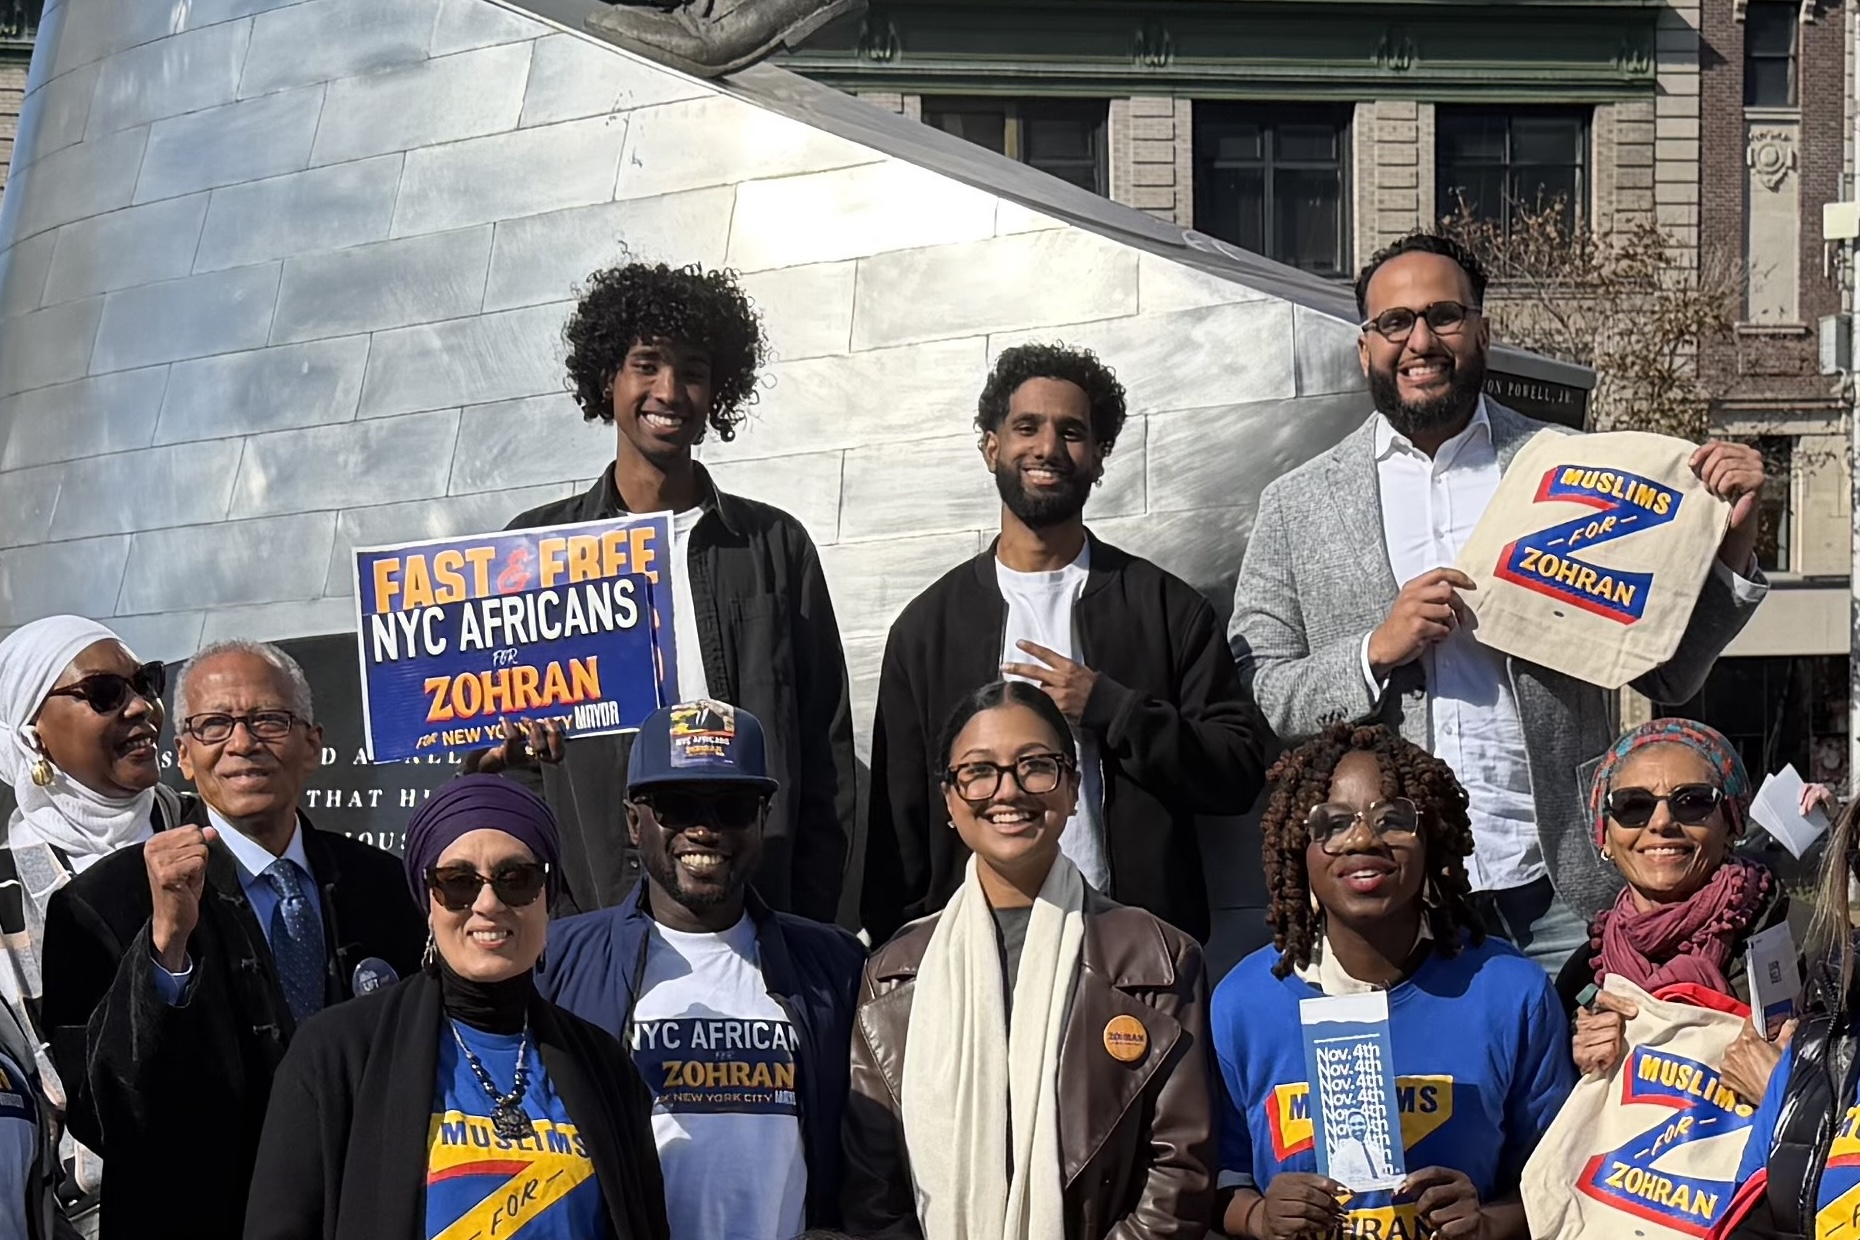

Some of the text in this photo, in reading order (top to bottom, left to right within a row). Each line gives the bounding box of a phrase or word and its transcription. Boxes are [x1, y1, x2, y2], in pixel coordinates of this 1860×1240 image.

[1508, 381, 1555, 404] POWELL,
[1560, 467, 1672, 515] MUSLIMS
[1569, 515, 1617, 546] FOR
[373, 546, 495, 613] FAST
[538, 527, 658, 588] FREE
[1519, 546, 1637, 607] ZOHRAN
[371, 579, 638, 662] NYC AFRICANS
[493, 647, 518, 667] FOR
[424, 655, 601, 723] ZOHRAN
[416, 733, 438, 749] FOR
[442, 726, 481, 746] NEW
[574, 701, 619, 729] MAYOR
[306, 789, 383, 808] THAT
[691, 1021, 799, 1051] AFRICAN
[1316, 1042, 1380, 1062] Nov. 4th
[661, 1060, 796, 1089] ZOHRAN
[1318, 1058, 1382, 1077] Nov. 4th
[1320, 1073, 1384, 1092] Nov. 4th
[673, 1093, 702, 1102] NEW
[706, 1093, 741, 1102] YORK
[744, 1093, 773, 1102] CITY
[1322, 1091, 1358, 1107] Nov.
[1651, 1116, 1694, 1157] FOR
[1605, 1161, 1718, 1220] ZOHRAN
[491, 1178, 538, 1235] FOR
